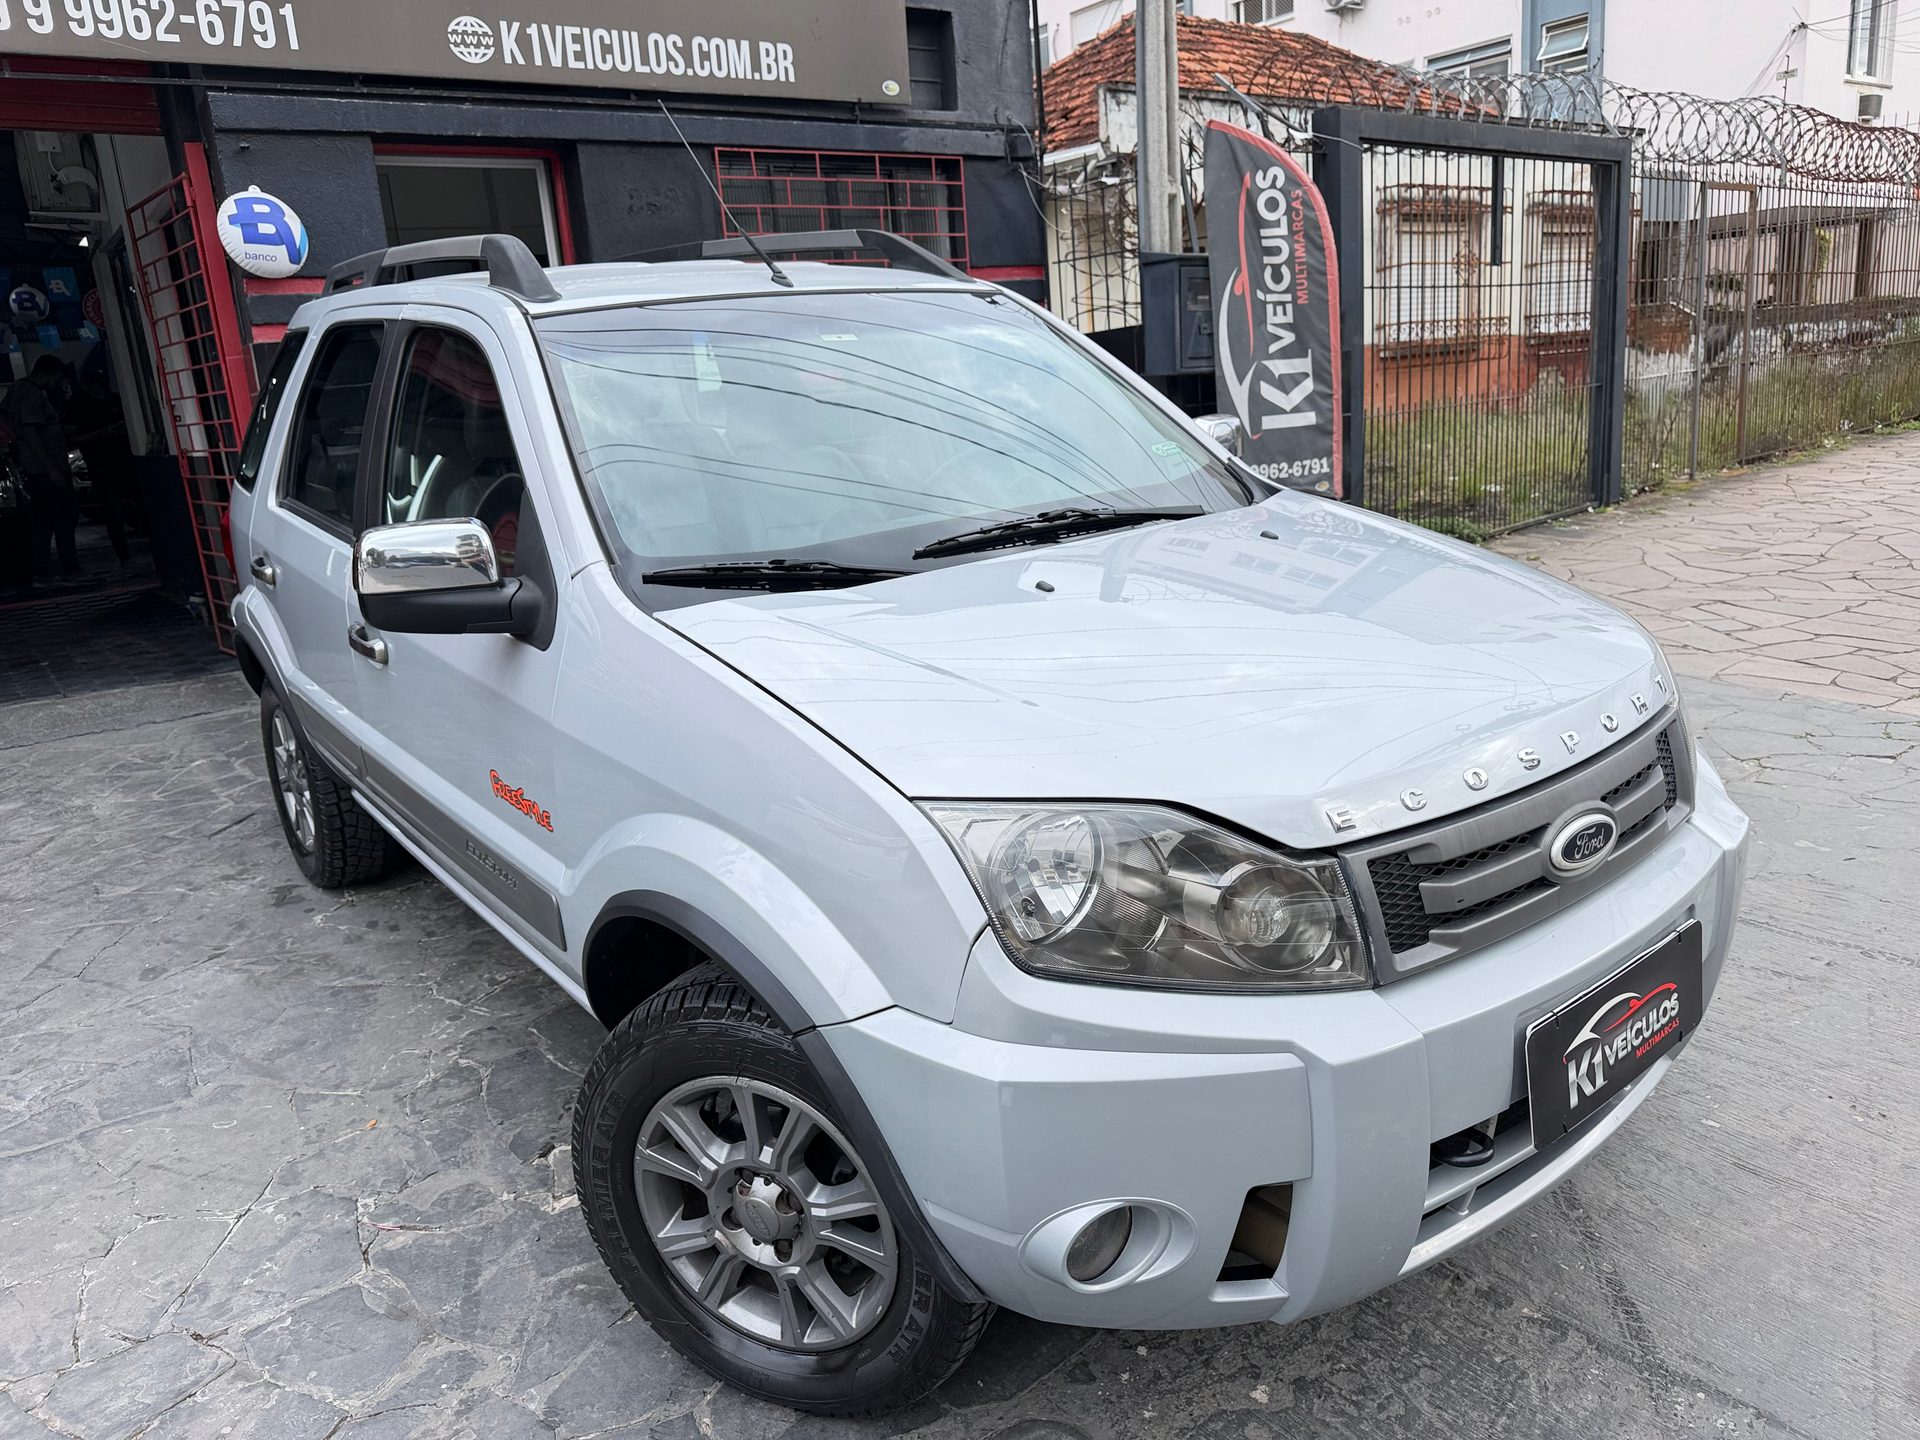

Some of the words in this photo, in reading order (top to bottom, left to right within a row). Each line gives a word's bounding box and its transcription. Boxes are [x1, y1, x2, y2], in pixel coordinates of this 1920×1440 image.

[64, 0, 300, 51] 9962-6791
[243, 250, 279, 264] banco
[1255, 165, 1297, 355] VEÍCULOS
[1290, 188, 1310, 305] MULTIMARCAS
[1259, 348, 1318, 431] K1
[1325, 673, 1672, 834] ECOSPORT
[1574, 826, 1606, 860] Ford
[1567, 1043, 1609, 1110] K1
[1603, 992, 1681, 1067] VEÍCULOS
[1635, 1017, 1681, 1059] MULTIMARCAS
